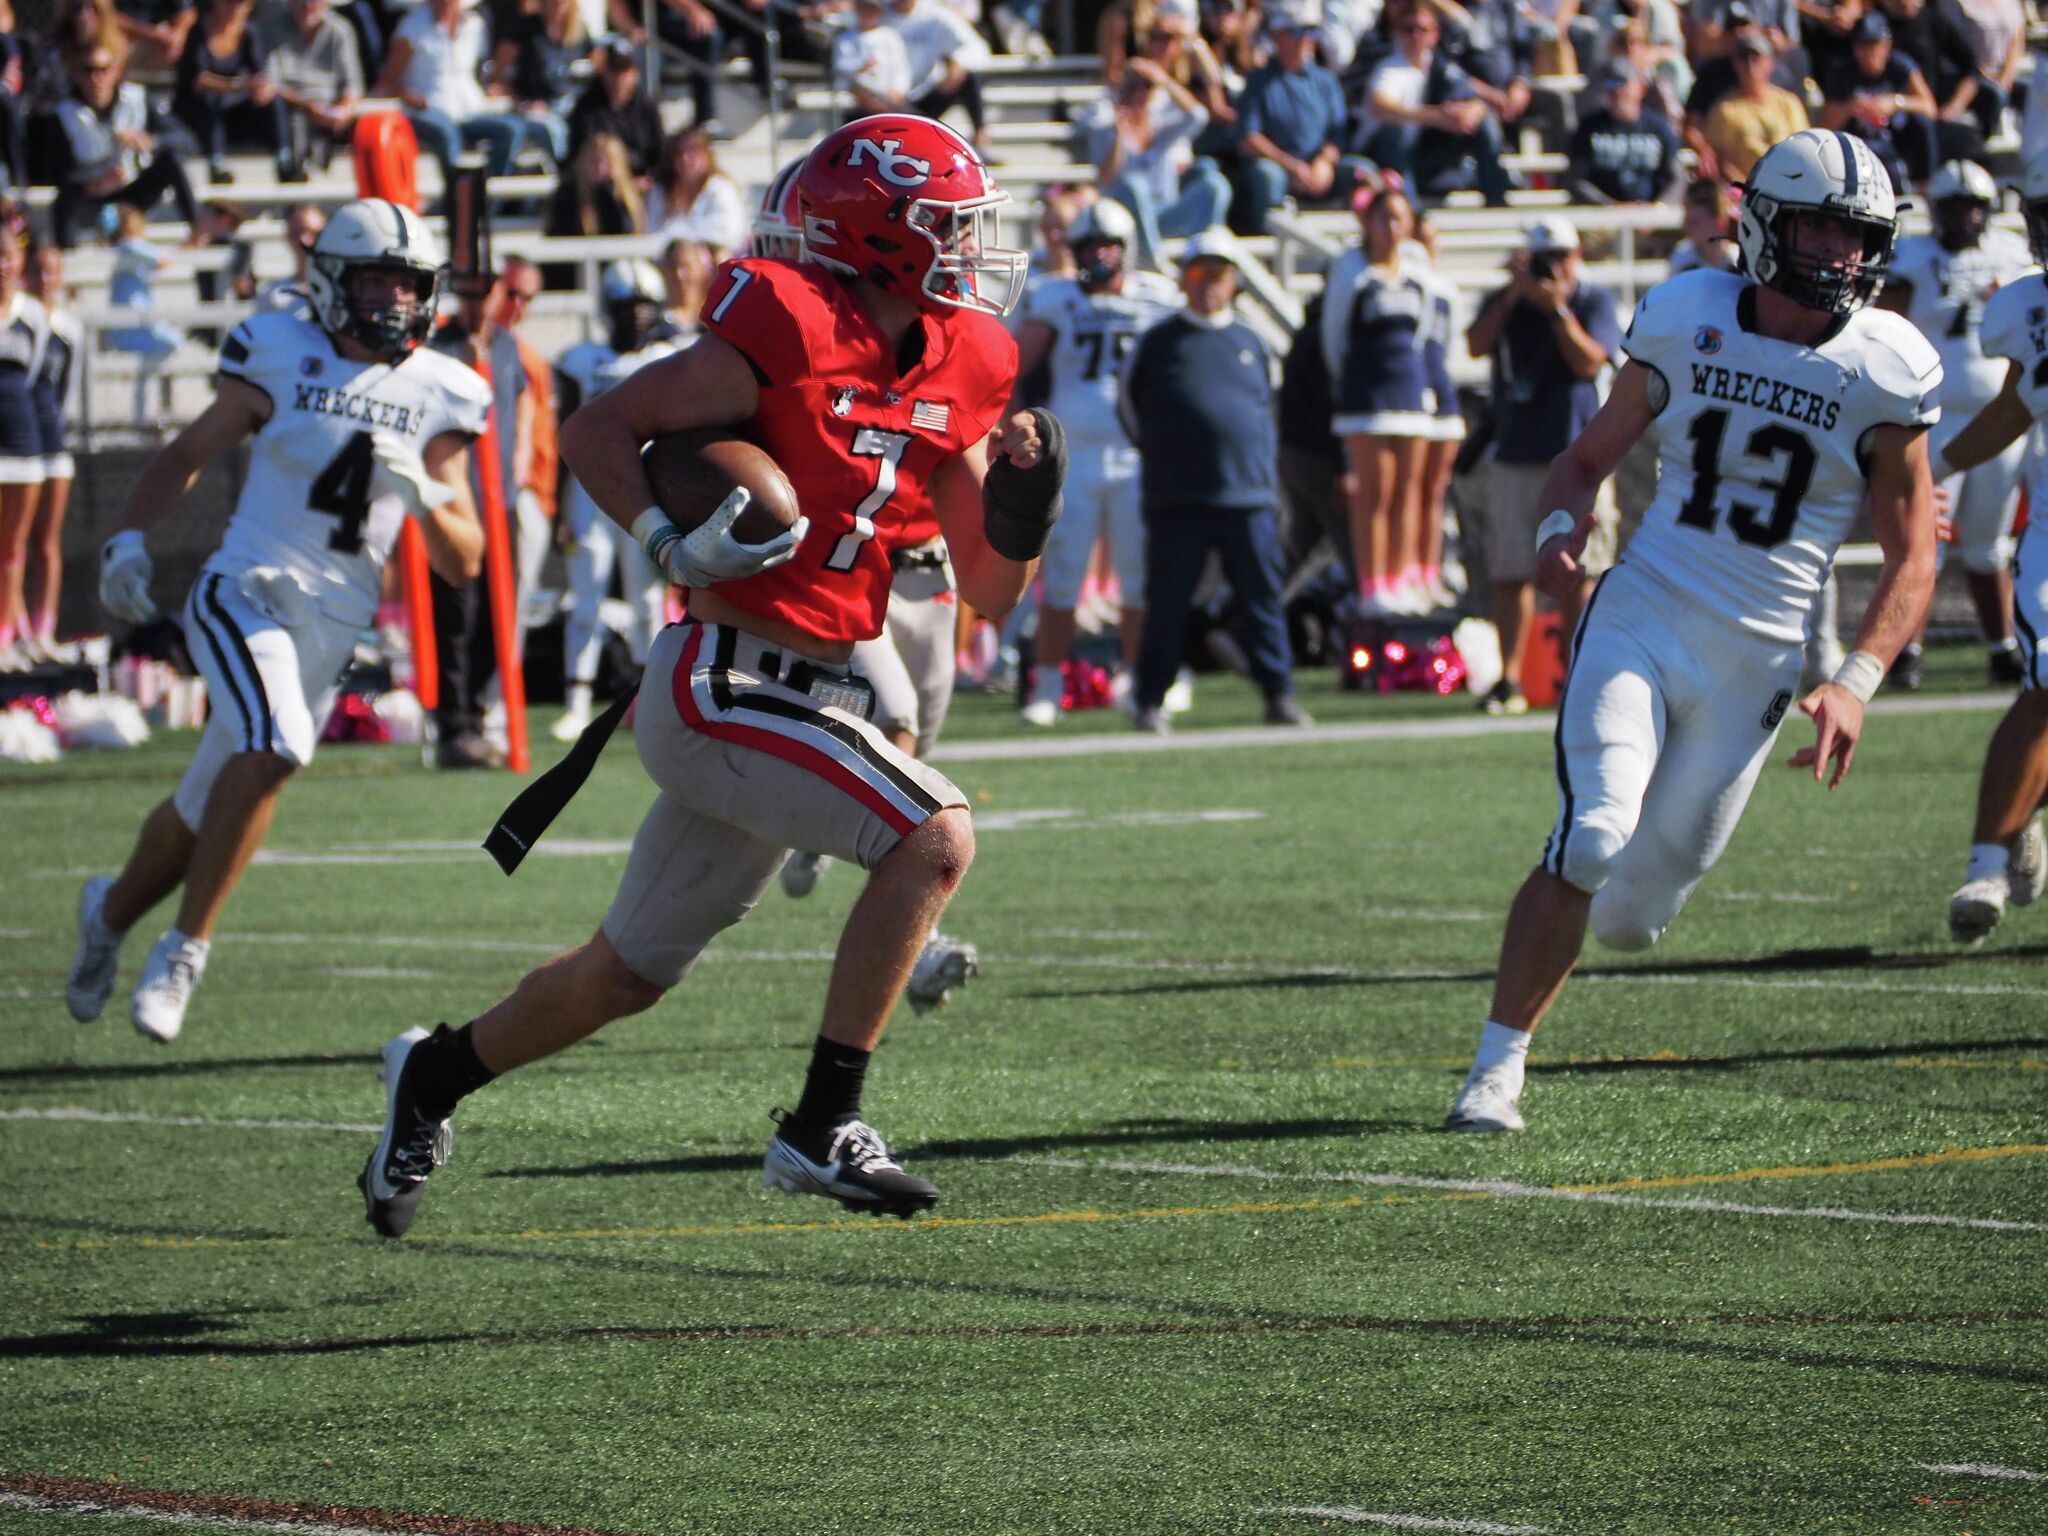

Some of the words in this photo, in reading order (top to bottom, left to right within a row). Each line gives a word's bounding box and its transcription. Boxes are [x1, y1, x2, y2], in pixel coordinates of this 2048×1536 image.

[846, 137, 932, 187] NC
[711, 265, 752, 323] 7
[294, 383, 425, 436] WRECKERS
[1690, 362, 1841, 431] WRECKERS
[306, 429, 375, 556] 4
[822, 425, 916, 573] 7
[1676, 405, 1819, 550] 13
